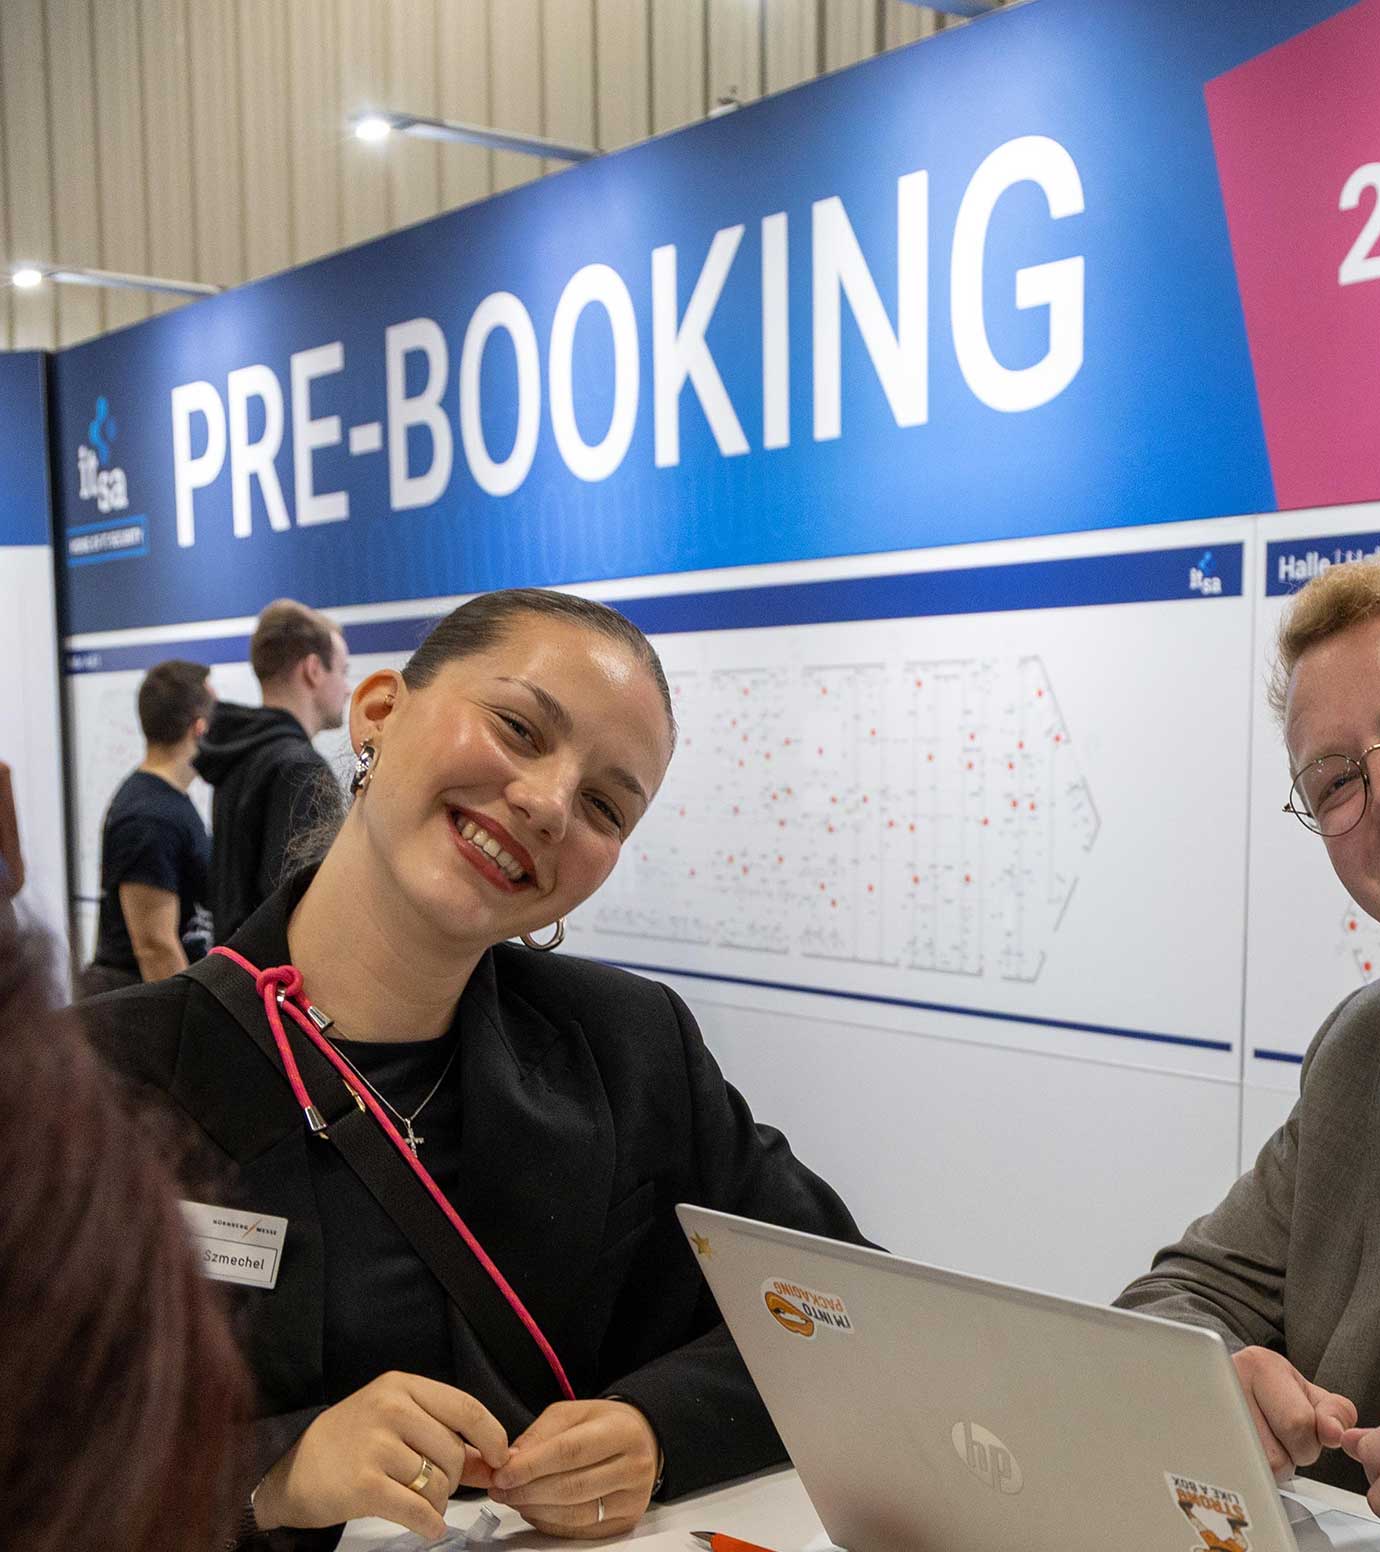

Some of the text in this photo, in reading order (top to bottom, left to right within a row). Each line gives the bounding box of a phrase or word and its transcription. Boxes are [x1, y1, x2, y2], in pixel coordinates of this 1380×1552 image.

[171, 135, 1085, 547] PRE-BOOKING
[1278, 551, 1331, 581] Halle
[203, 1249, 265, 1270] Szmechel
[773, 1282, 844, 1312] PACKAGING
